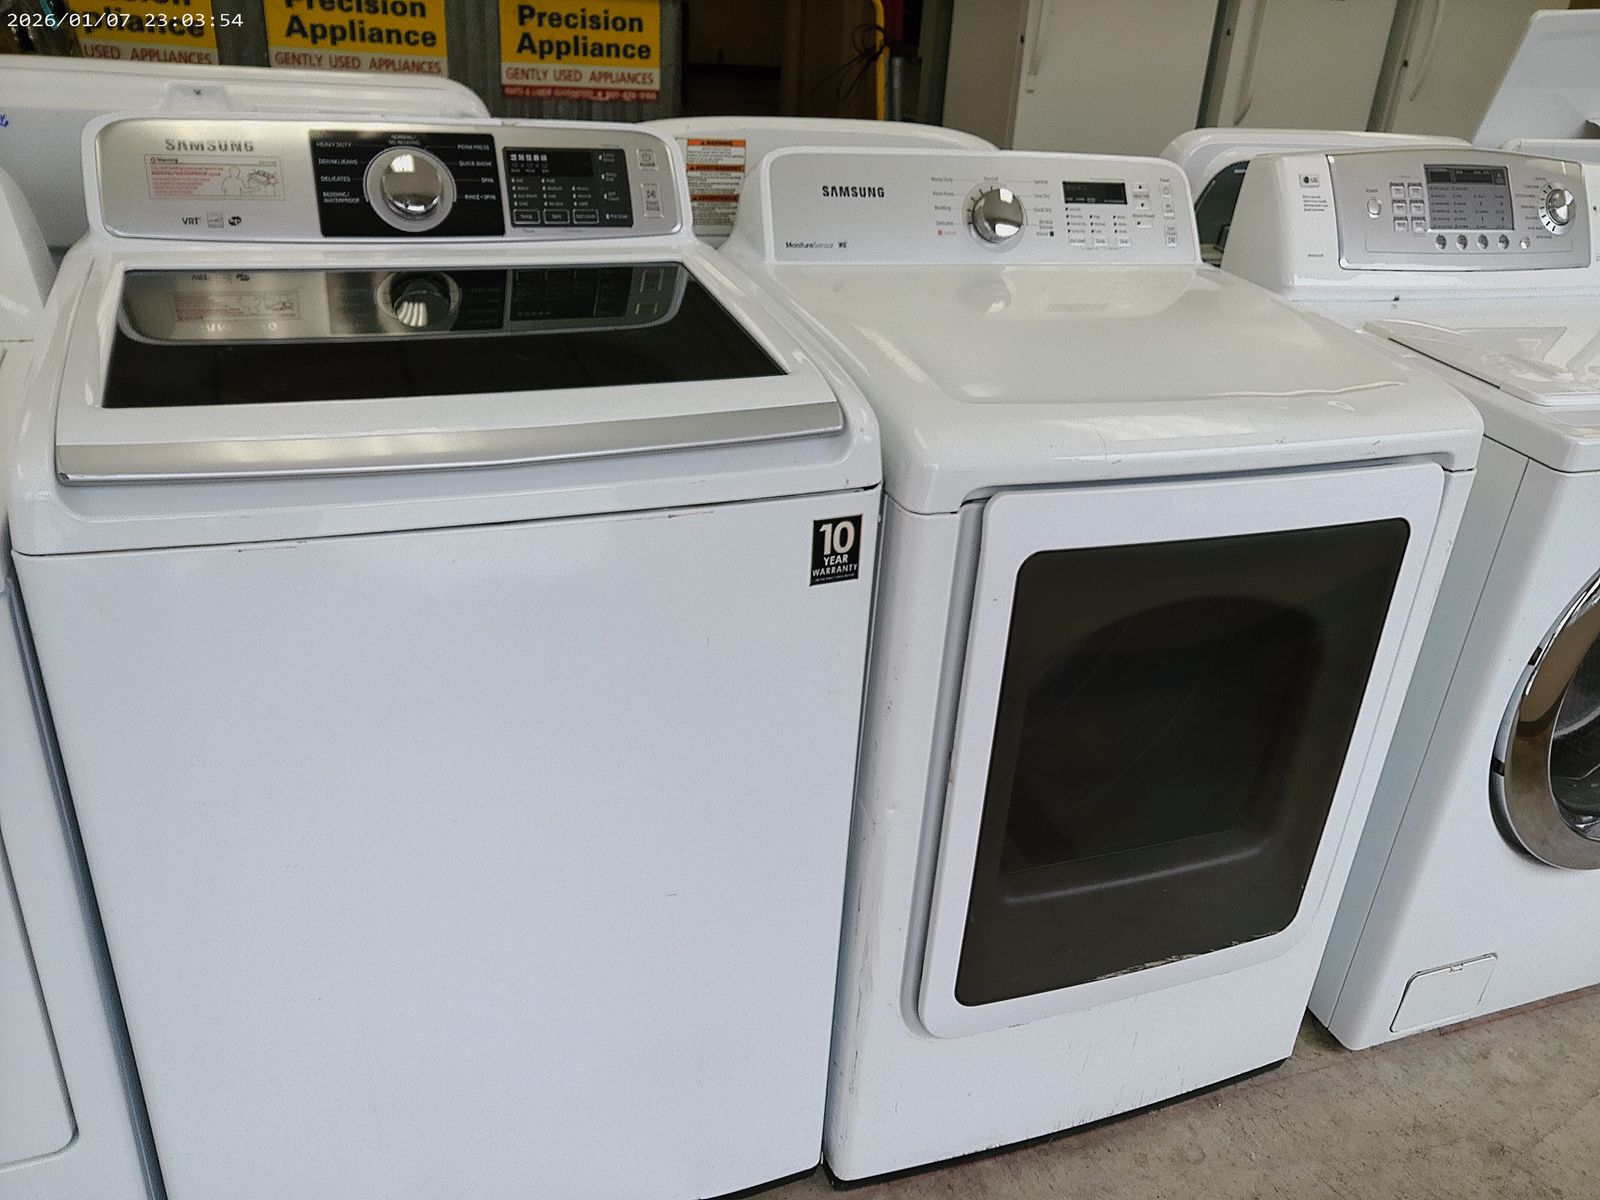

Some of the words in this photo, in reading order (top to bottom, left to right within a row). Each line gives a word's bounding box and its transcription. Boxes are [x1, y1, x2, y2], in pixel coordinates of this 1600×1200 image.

[517, 4, 644, 33] Precision
[285, 14, 437, 47] Appliance
[83, 44, 121, 60] USED
[130, 48, 212, 65] APPLIANCES
[517, 32, 651, 60] Appliance
[274, 51, 324, 67] GENTLY
[328, 55, 361, 71] USED
[368, 57, 442, 75] APPLIANCES
[505, 67, 549, 81] GENTLY
[553, 69, 583, 83] USED
[588, 71, 654, 86] APPLIANCES
[164, 138, 255, 152] SAMSUNG
[822, 185, 885, 198] SAMSUNG
[820, 521, 855, 555] 10
[812, 563, 858, 577] WARRANTY
[824, 554, 849, 566] YEAR
